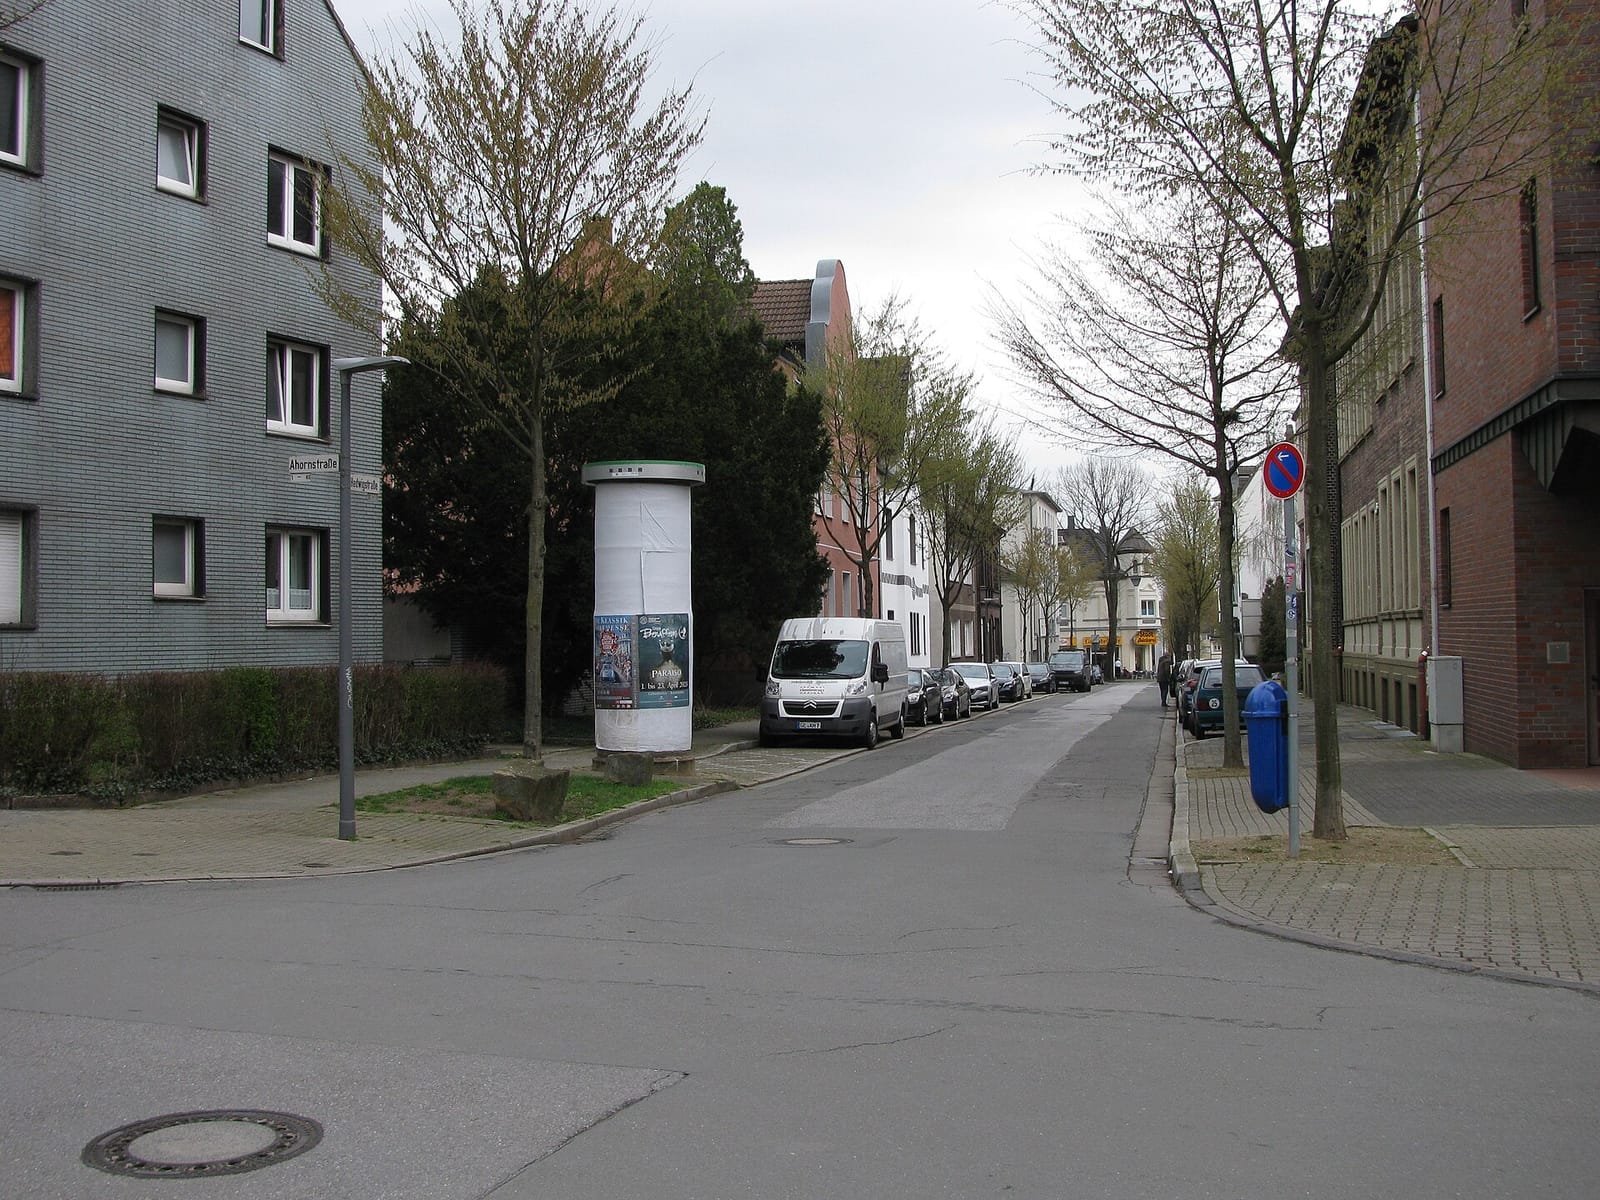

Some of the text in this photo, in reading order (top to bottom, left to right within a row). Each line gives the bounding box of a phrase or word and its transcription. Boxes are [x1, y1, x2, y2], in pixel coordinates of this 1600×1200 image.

[289, 458, 338, 470] Ahornstraße
[651, 669, 682, 678] PARAISO
[667, 681, 679, 690] April
